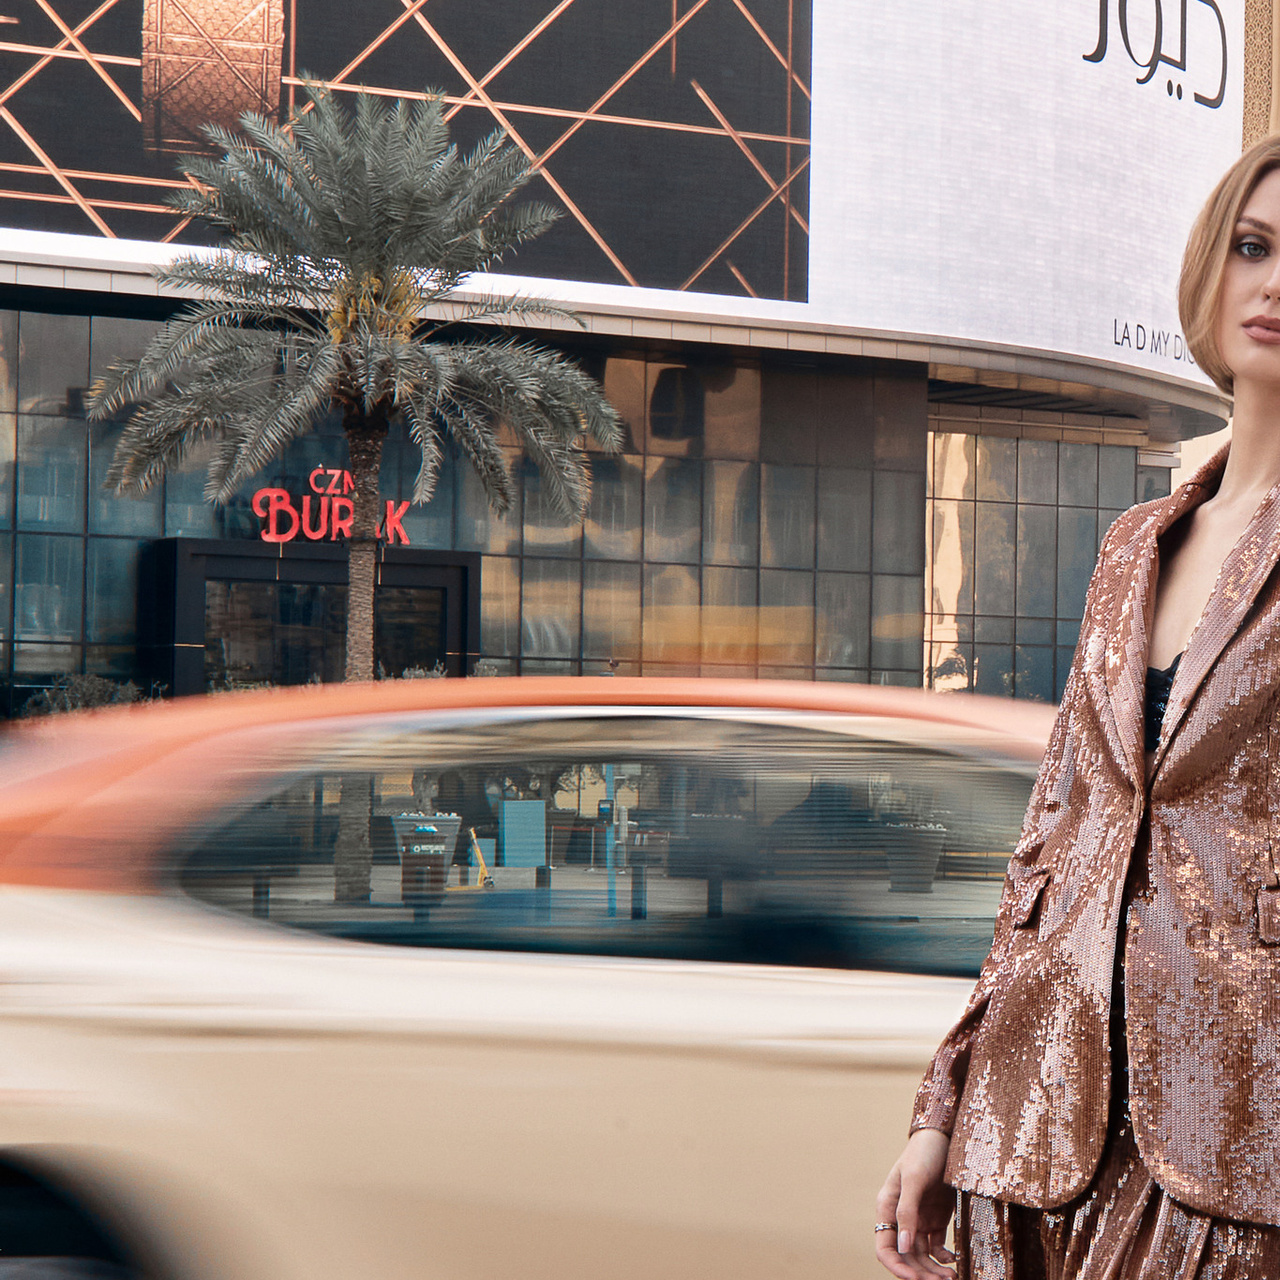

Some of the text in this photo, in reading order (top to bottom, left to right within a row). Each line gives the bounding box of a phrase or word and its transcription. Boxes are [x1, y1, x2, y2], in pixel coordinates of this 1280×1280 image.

[1114, 318, 1132, 348] LA
[1136, 323, 1146, 351] D
[1150, 328, 1170, 357] MY
[251, 487, 411, 546] BURK
